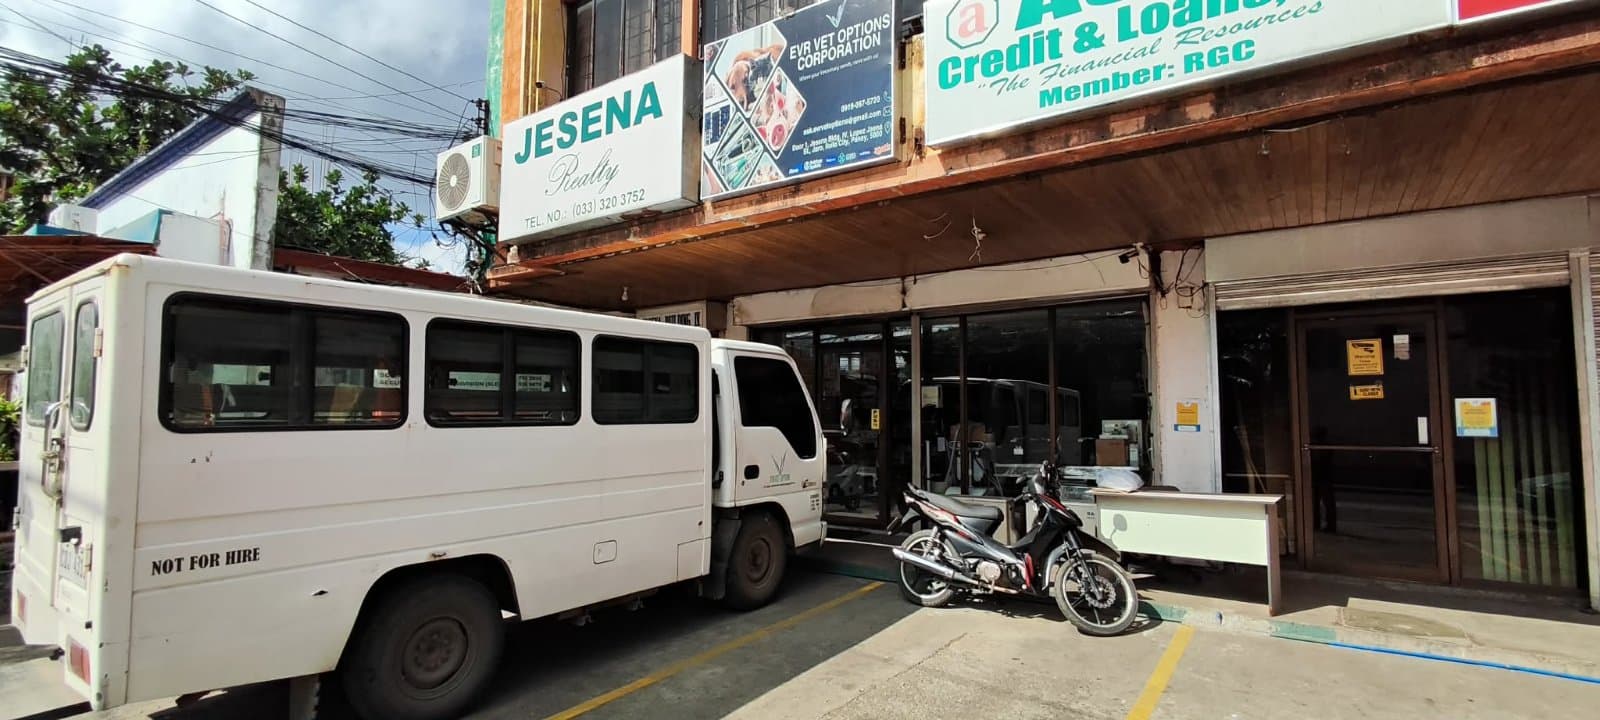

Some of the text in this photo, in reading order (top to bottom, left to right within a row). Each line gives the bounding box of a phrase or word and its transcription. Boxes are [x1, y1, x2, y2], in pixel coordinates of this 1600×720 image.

[789, 13, 891, 60] EVR VET OPTIONS
[797, 32, 881, 71] CORPORATION
[938, 27, 1063, 90] Credit
[1073, 21, 1105, 53] &
[1039, 36, 1162, 86] Financial
[1173, 0, 1323, 50] Resources
[1039, 39, 1256, 109] Member: RGC
[514, 81, 663, 164] JESENA
[544, 148, 619, 196] Realty
[572, 201, 597, 219] (033)
[599, 195, 618, 211] 320
[620, 188, 646, 207] 3752
[151, 547, 260, 576] NOT FOR HIRE
